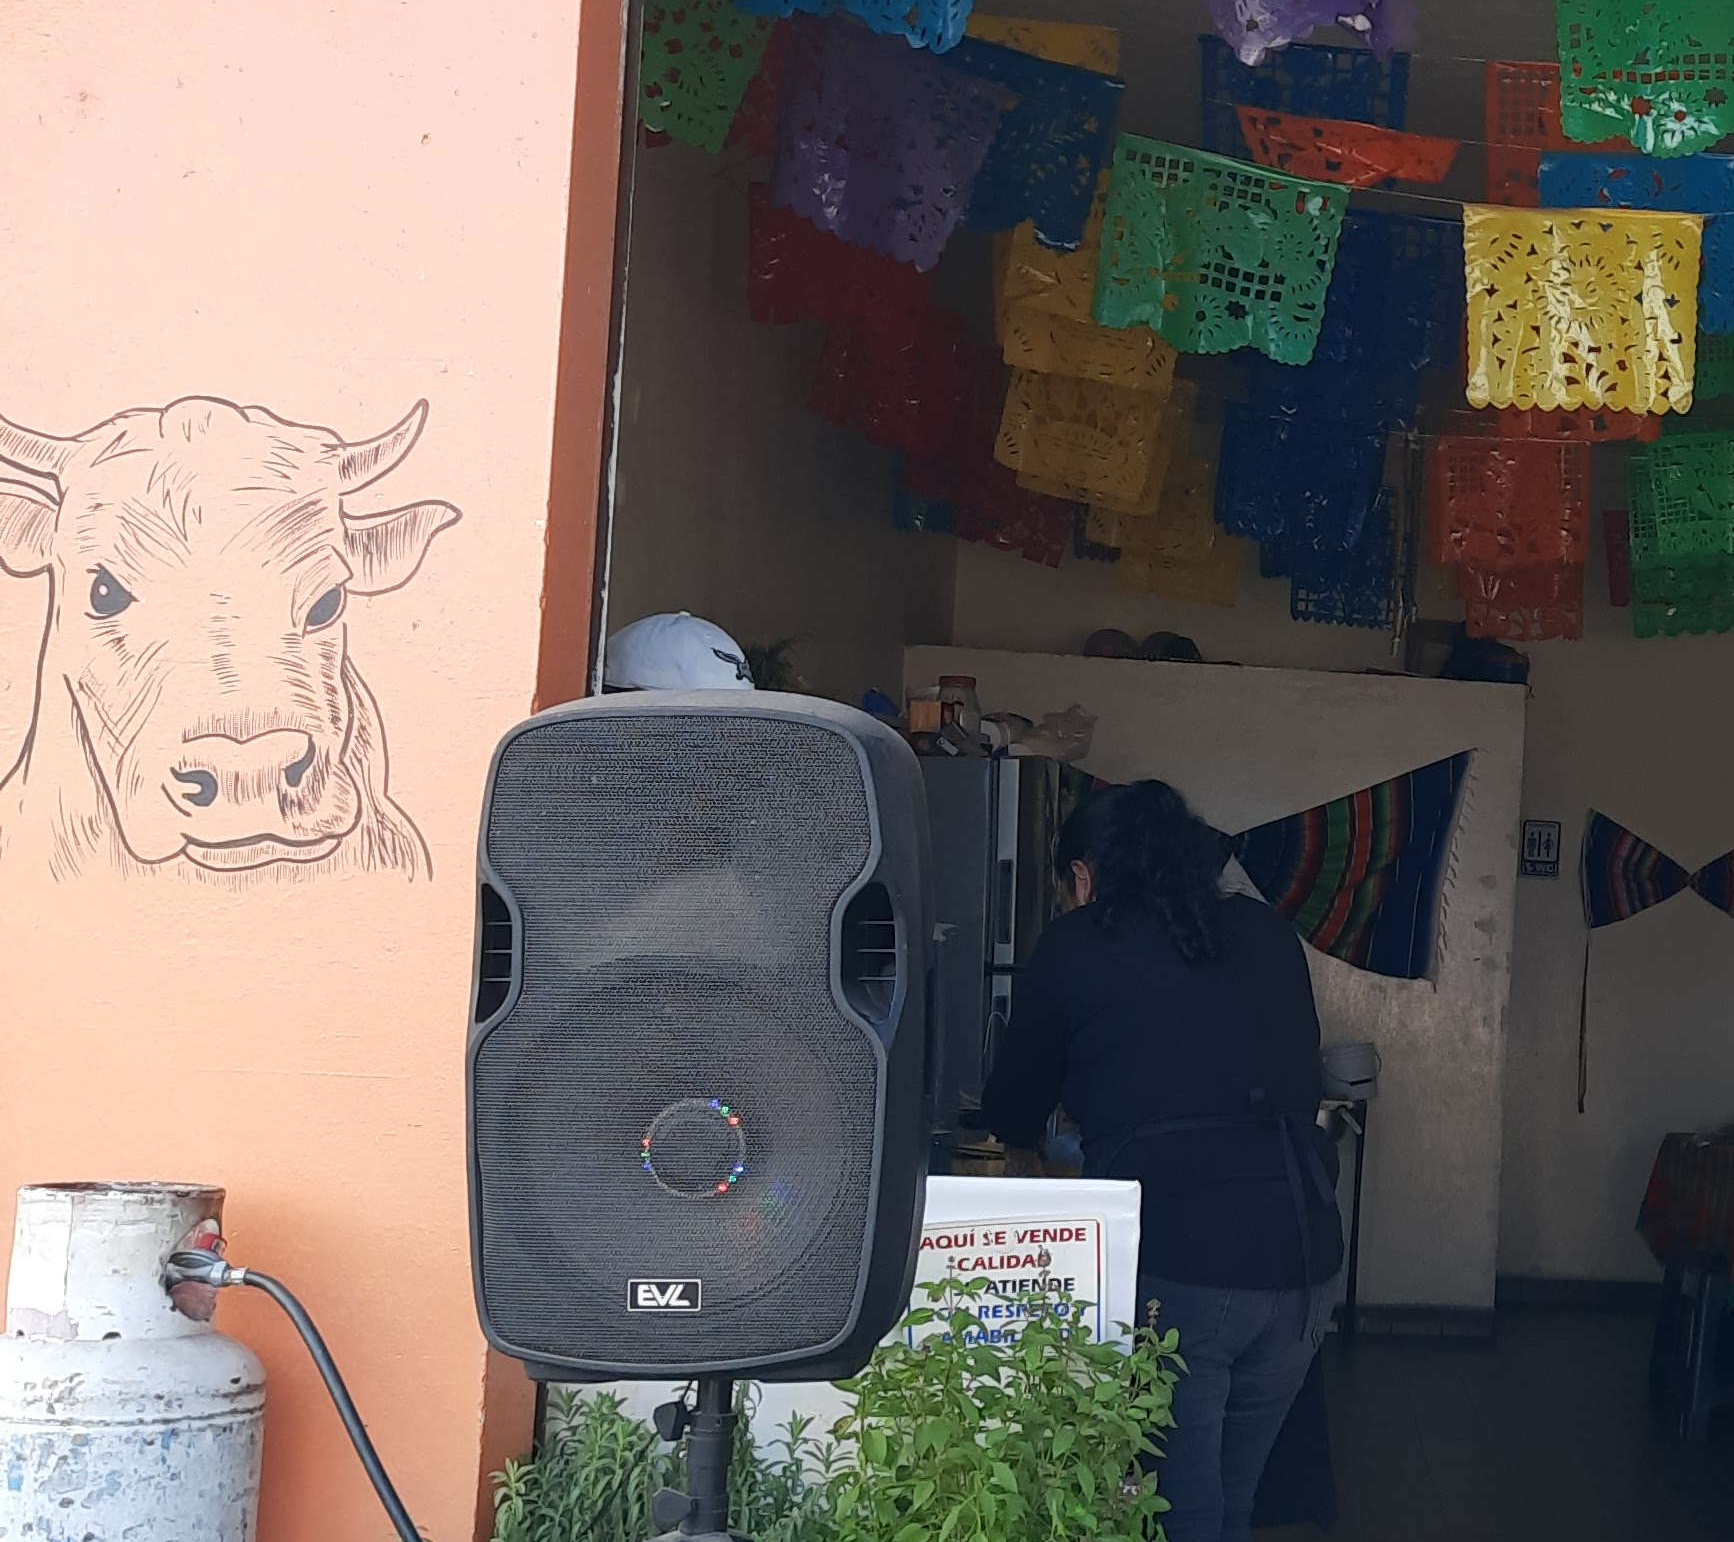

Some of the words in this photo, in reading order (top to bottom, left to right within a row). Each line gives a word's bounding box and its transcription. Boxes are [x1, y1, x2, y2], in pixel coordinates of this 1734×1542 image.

[919, 1229, 975, 1251] AQUÍ
[982, 1231, 1006, 1246] SE
[1014, 1227, 1087, 1244] VENDE
[637, 1284, 691, 1306] EVL
